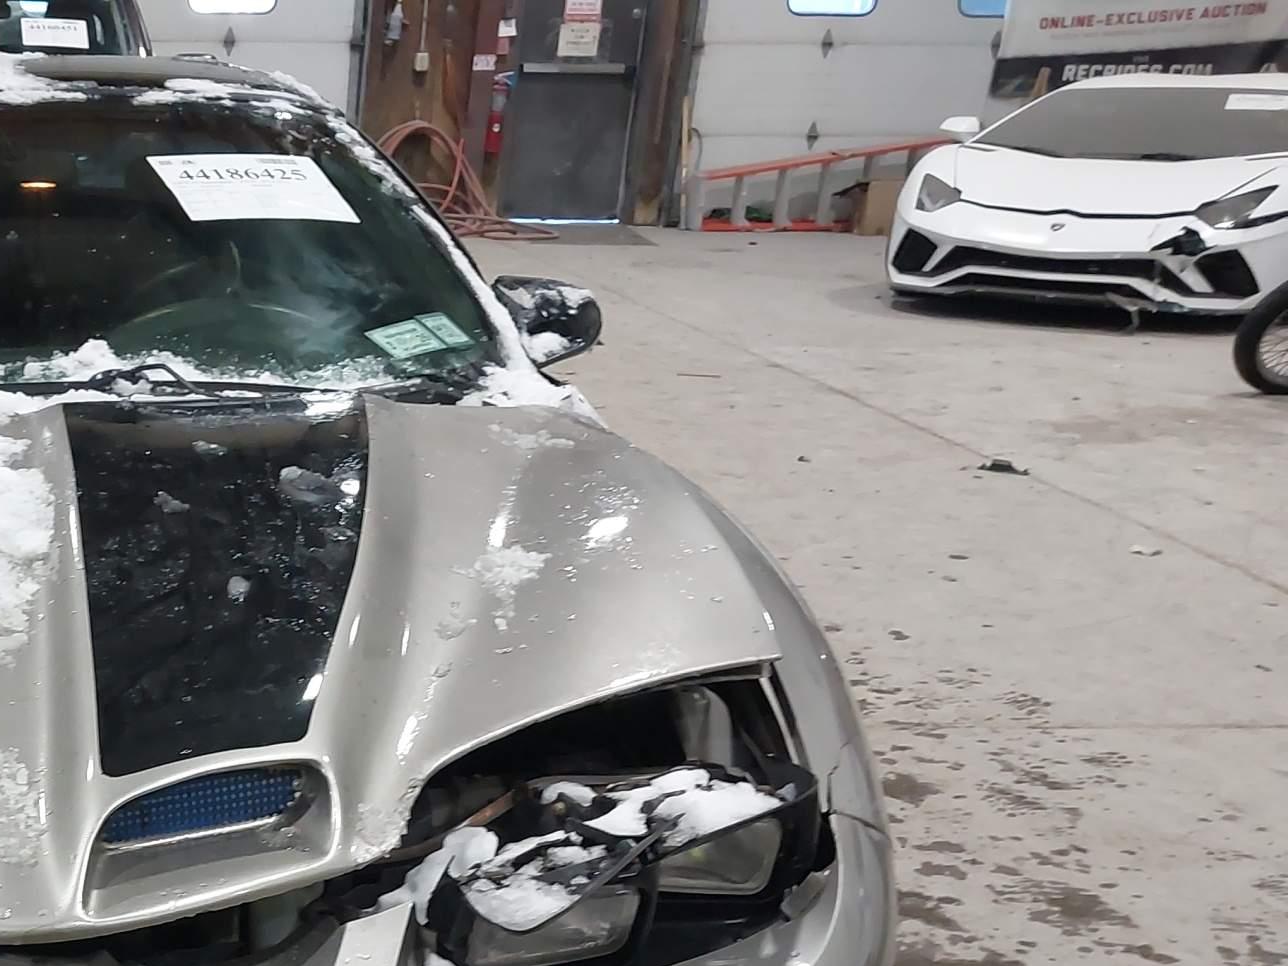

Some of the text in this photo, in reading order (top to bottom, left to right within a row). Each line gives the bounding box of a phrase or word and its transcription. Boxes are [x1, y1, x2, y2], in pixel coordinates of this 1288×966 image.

[1039, 3, 1268, 30] ONLINE-EXCLUSIVE AUCTION
[1062, 64, 1213, 81] RECRIDESCOM
[179, 168, 307, 181] 44186425
